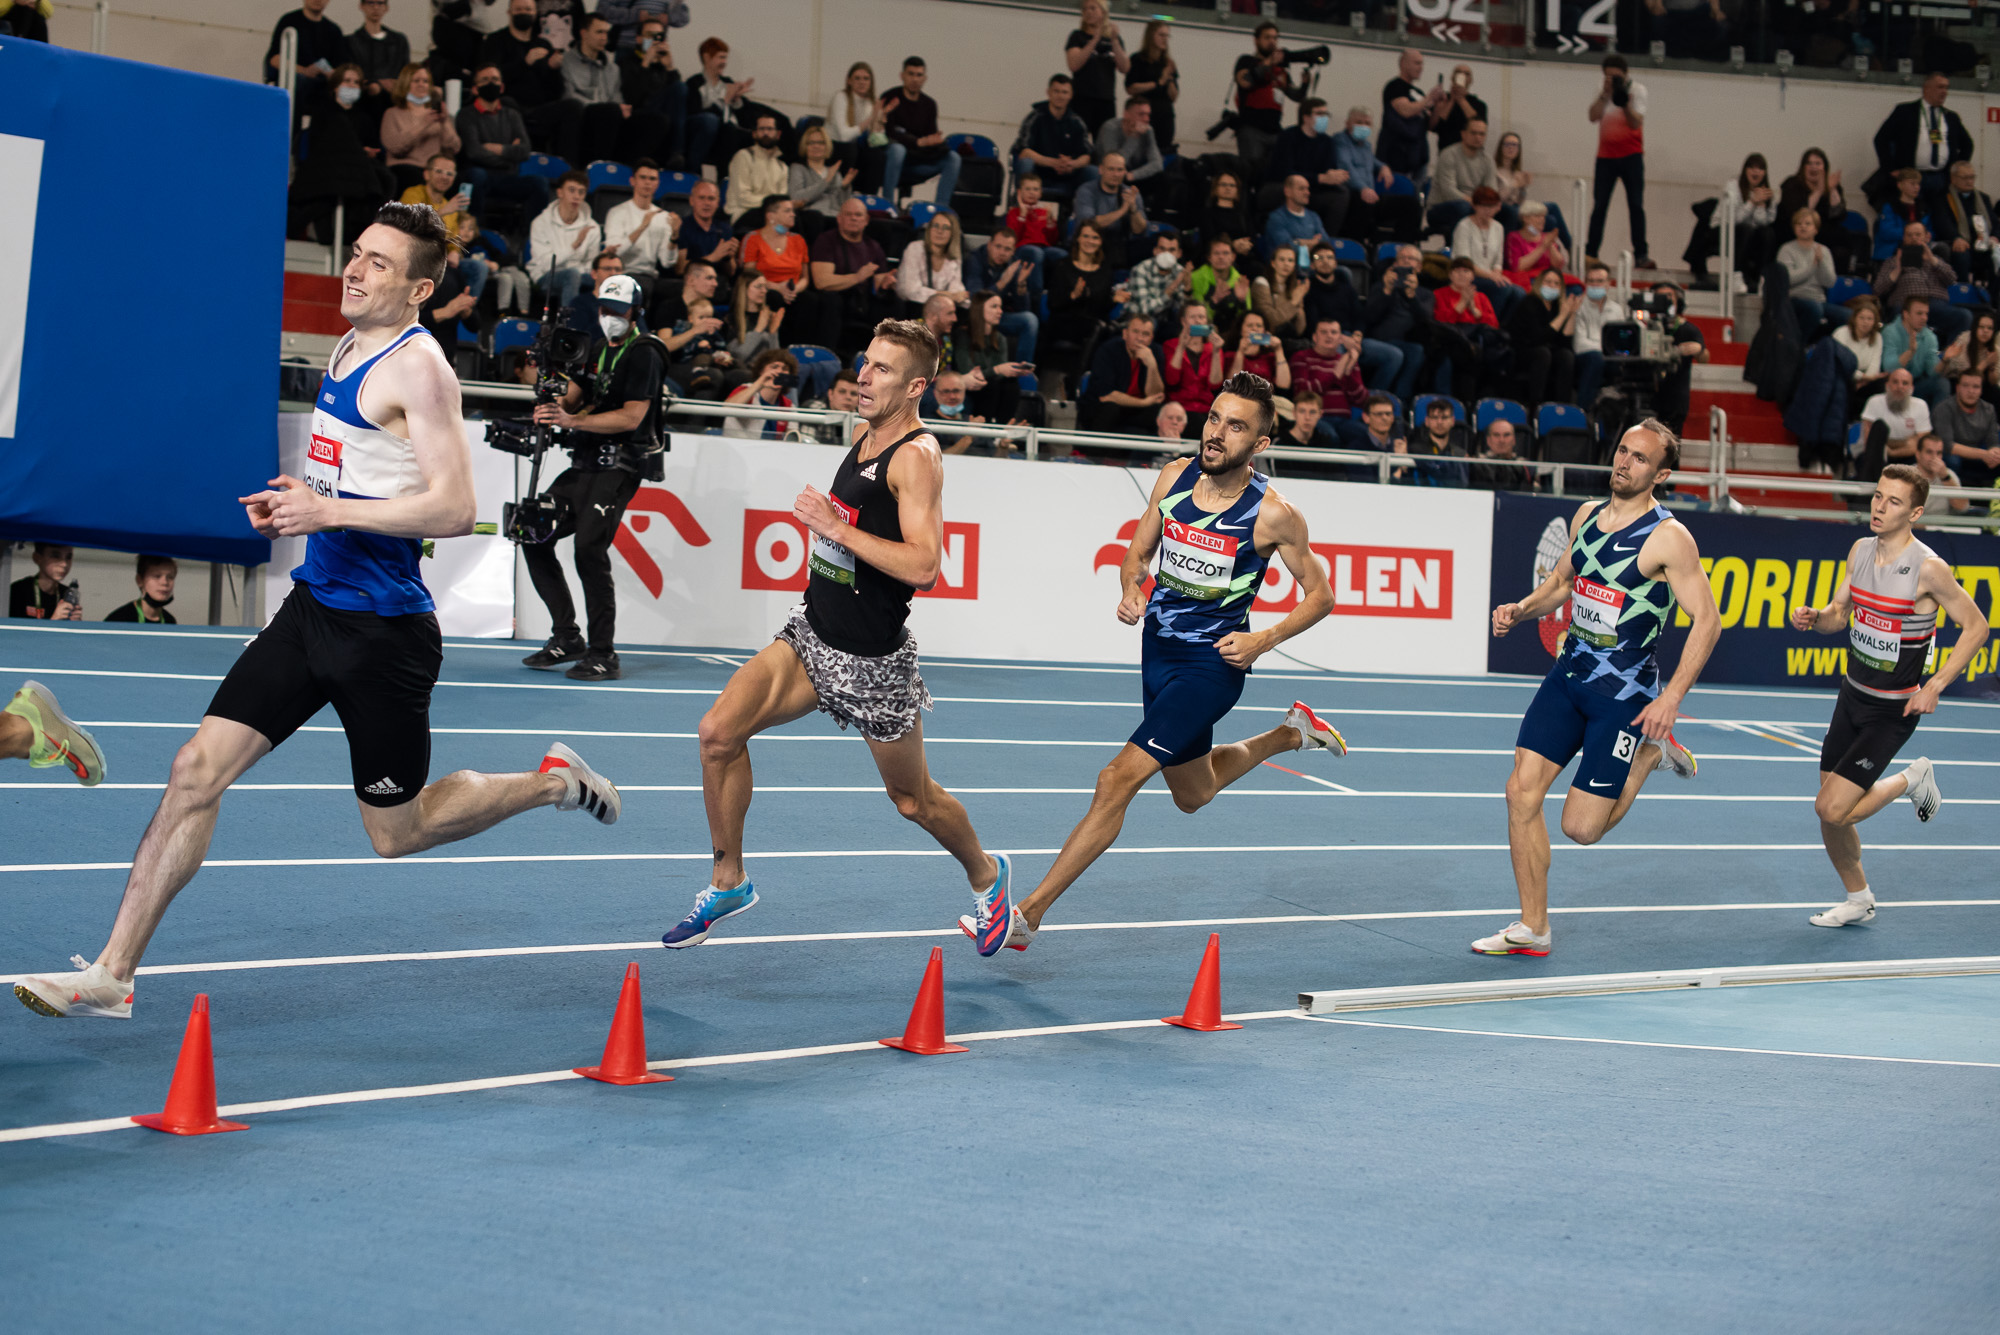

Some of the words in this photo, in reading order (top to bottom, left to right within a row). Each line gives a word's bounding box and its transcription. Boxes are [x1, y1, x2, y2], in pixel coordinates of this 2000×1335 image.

[1189, 532, 1223, 549] ORLEN
[819, 564, 837, 578] 2022
[1185, 586, 1206, 598] 2022
[1587, 586, 1613, 601] ORLEN
[1577, 604, 1602, 624] TUKA
[1866, 615, 1890, 629] ORLEN
[1618, 735, 1631, 758] 3
[364, 786, 404, 795] adidas
